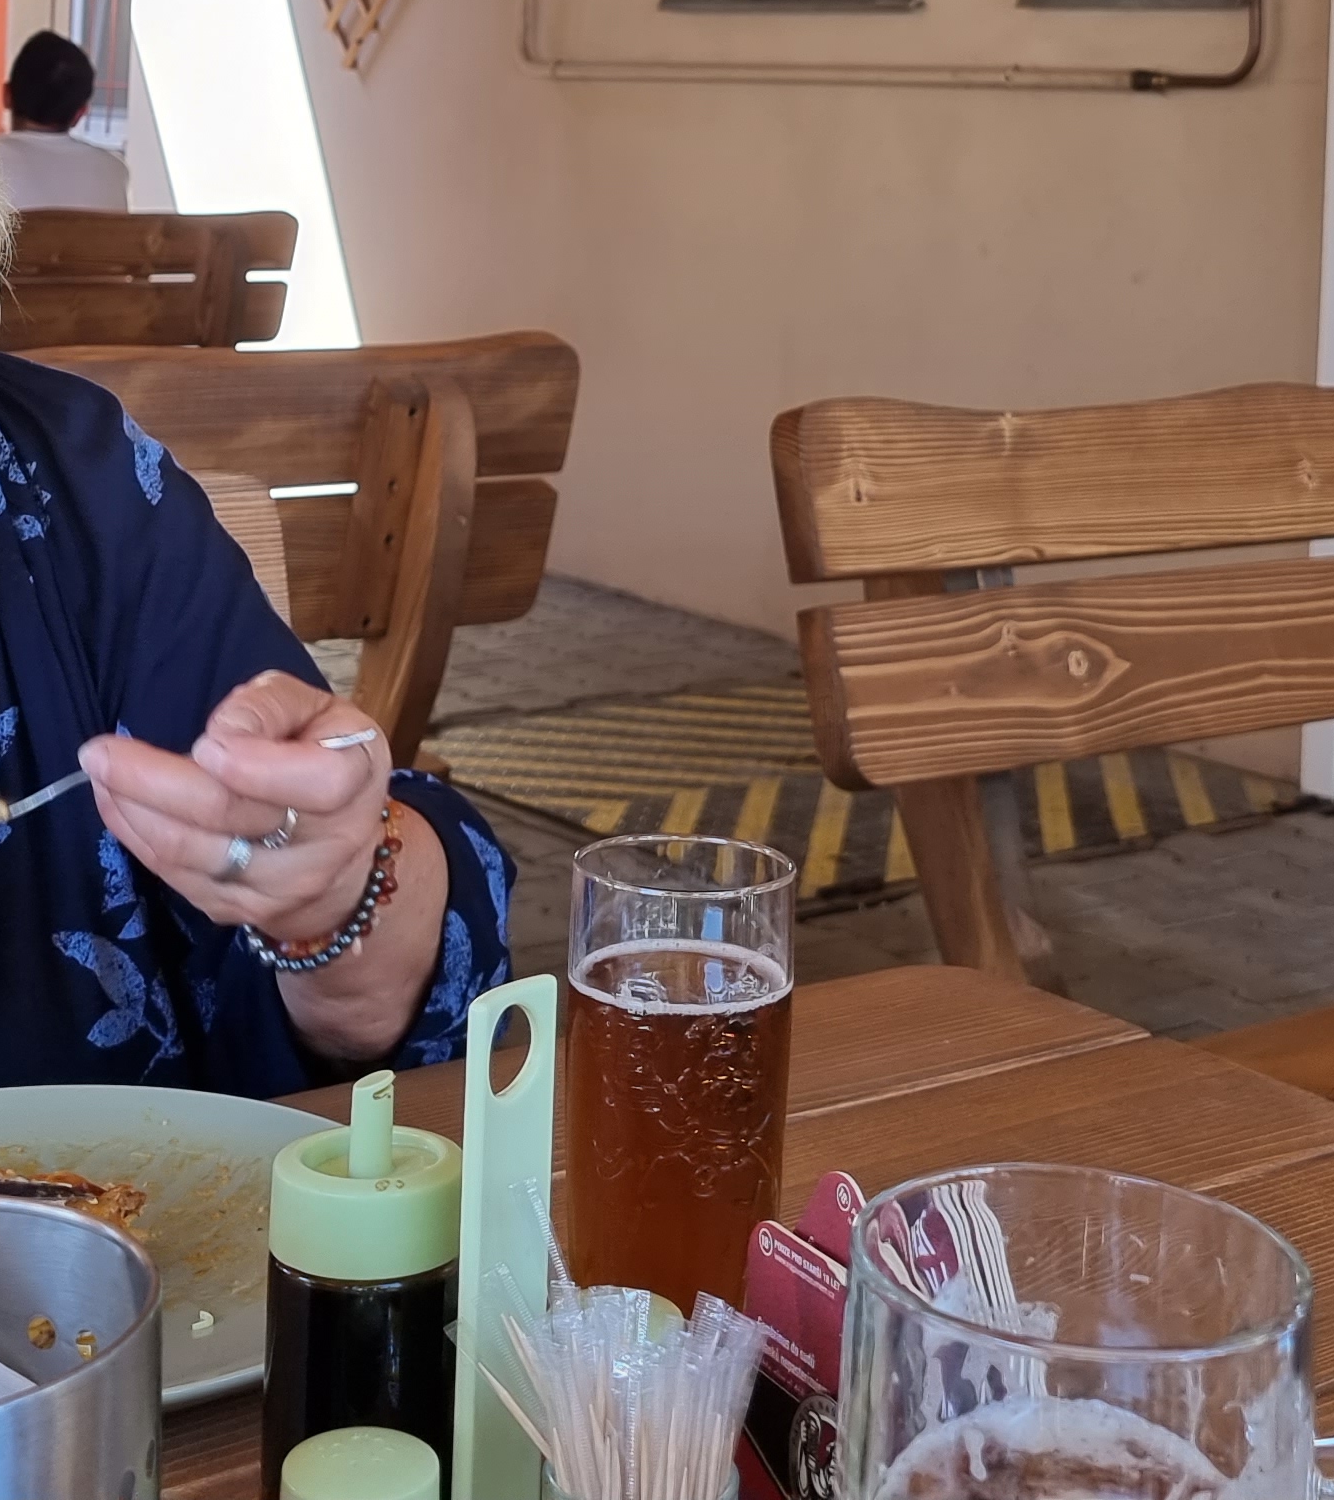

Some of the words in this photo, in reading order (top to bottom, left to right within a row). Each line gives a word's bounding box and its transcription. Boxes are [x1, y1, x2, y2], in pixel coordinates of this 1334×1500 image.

[774, 1239, 790, 1259] POUZE
[791, 1250, 803, 1266] PRO
[830, 1276, 841, 1292] LET
